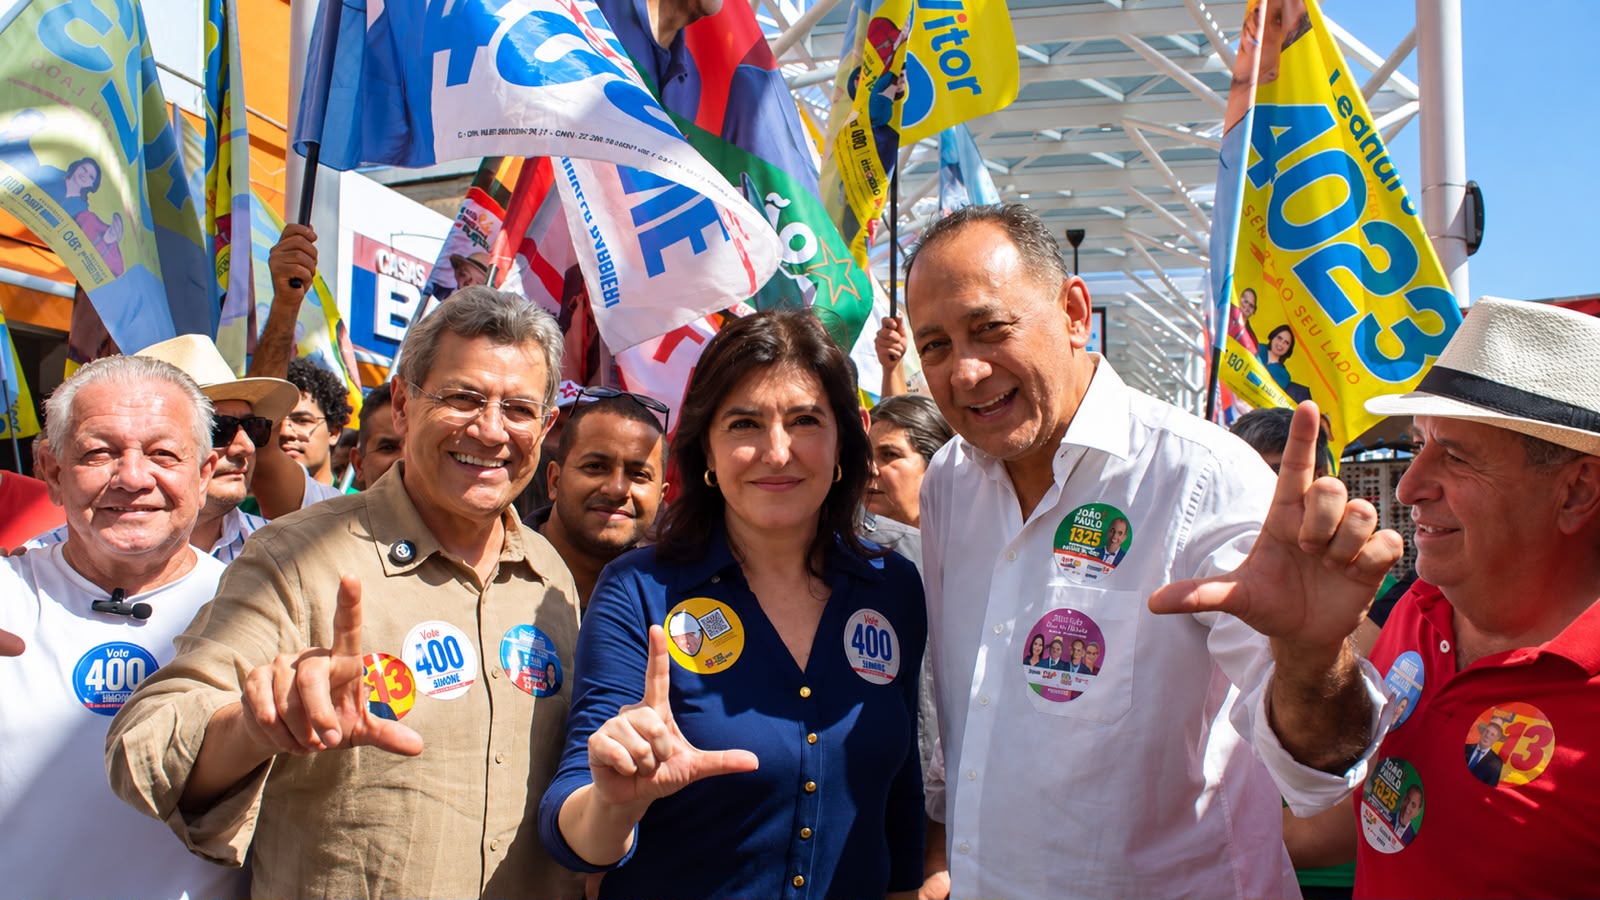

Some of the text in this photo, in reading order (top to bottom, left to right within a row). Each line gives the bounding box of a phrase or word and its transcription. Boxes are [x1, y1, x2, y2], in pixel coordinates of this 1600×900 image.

[1247, 104, 1464, 384] 4023
[375, 248, 427, 289] CASAS
[1294, 304, 1322, 337] SEU
[1321, 339, 1360, 386] LADO
[1069, 527, 1102, 547] 1325
[1074, 515, 1102, 529] PAULO
[106, 647, 129, 659] Vote
[419, 628, 440, 640] Vote
[851, 623, 892, 662] 400
[85, 657, 145, 691] 400
[415, 635, 465, 676] 400
[368, 663, 412, 704] 13
[1499, 721, 1554, 772] 13
